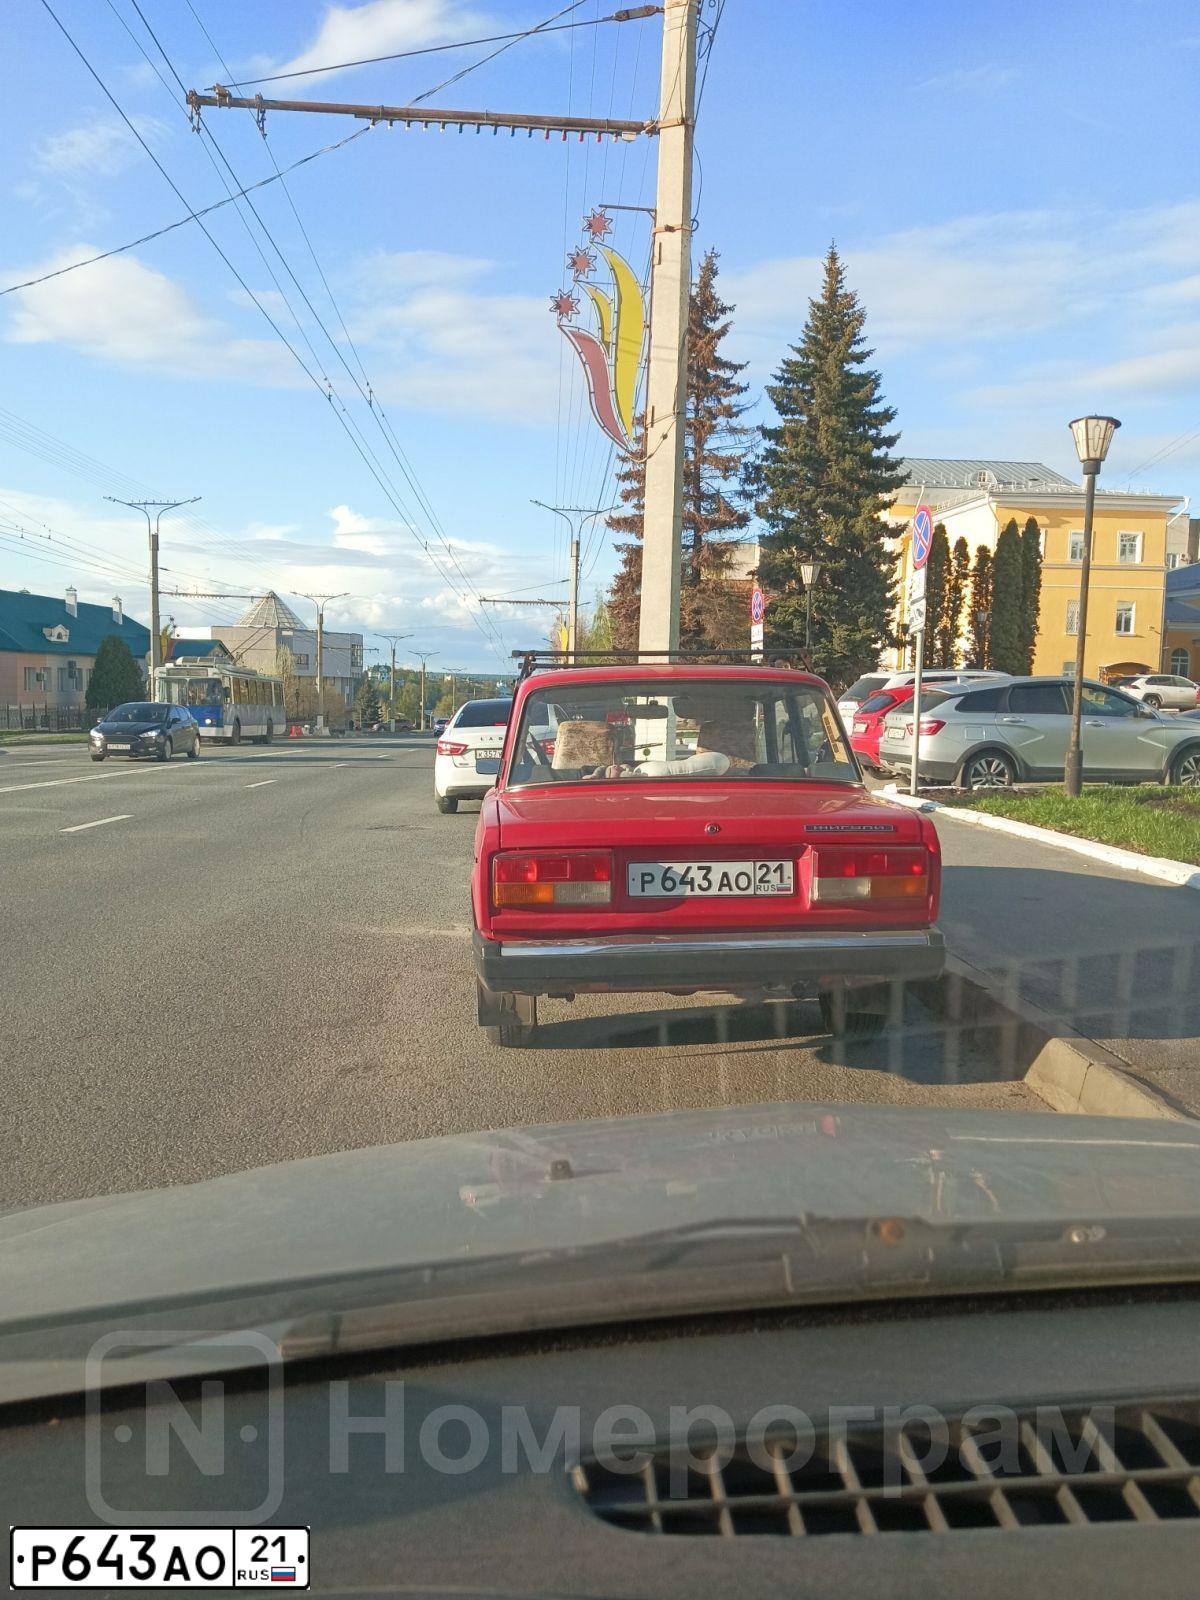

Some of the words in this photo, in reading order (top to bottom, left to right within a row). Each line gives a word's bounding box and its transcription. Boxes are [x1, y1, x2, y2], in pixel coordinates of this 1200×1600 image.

[640, 865, 751, 892] Р643АО
[757, 863, 785, 884] 21
[756, 884, 777, 892] RUS
